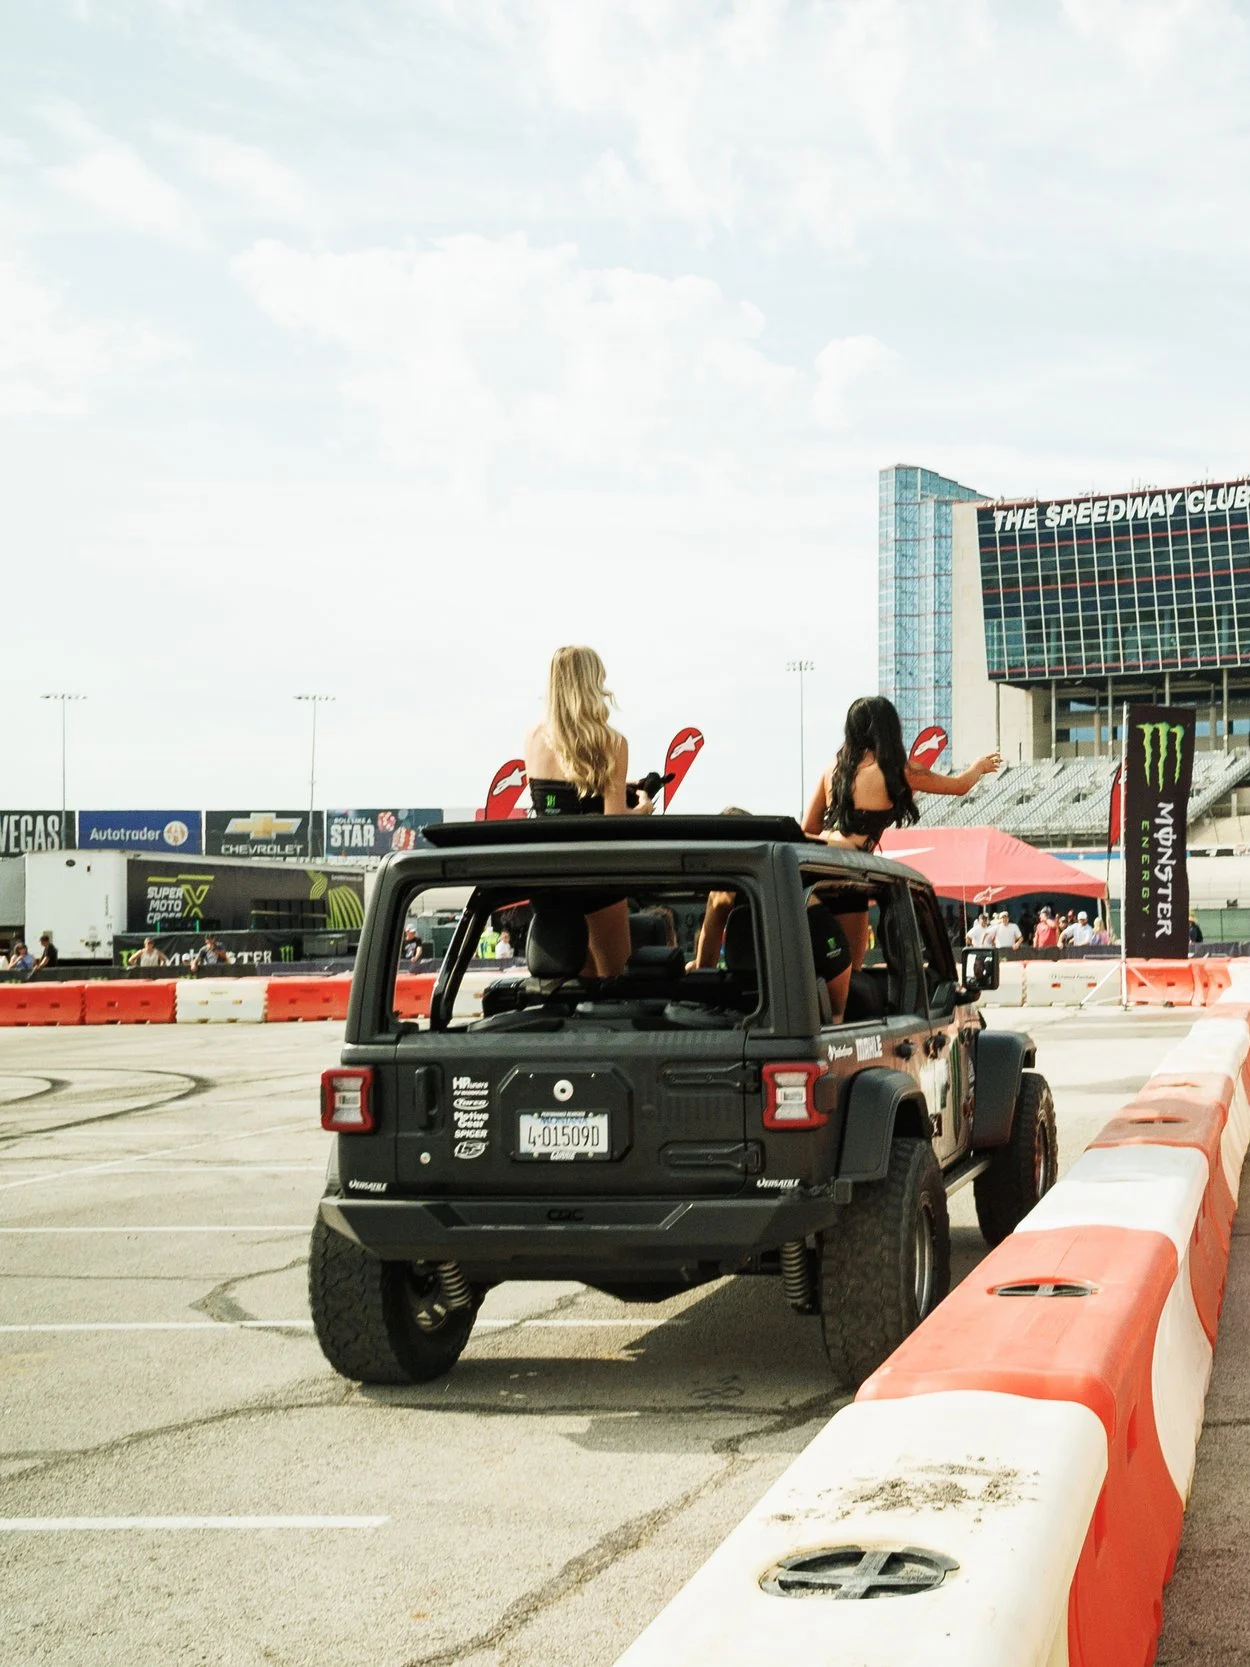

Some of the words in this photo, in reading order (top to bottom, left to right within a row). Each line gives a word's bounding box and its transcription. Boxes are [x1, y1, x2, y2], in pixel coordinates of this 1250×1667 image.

[993, 508, 1037, 532] THE
[1045, 492, 1183, 527] SPEEDWAY
[89, 826, 161, 841] Autotrader
[330, 824, 375, 847] STAR
[221, 844, 304, 855] CHEVROLET
[1141, 820, 1150, 915] ENERGY
[1153, 802, 1177, 939] MONSTER
[147, 886, 184, 899] SUPER
[149, 900, 182, 911] MOTO
